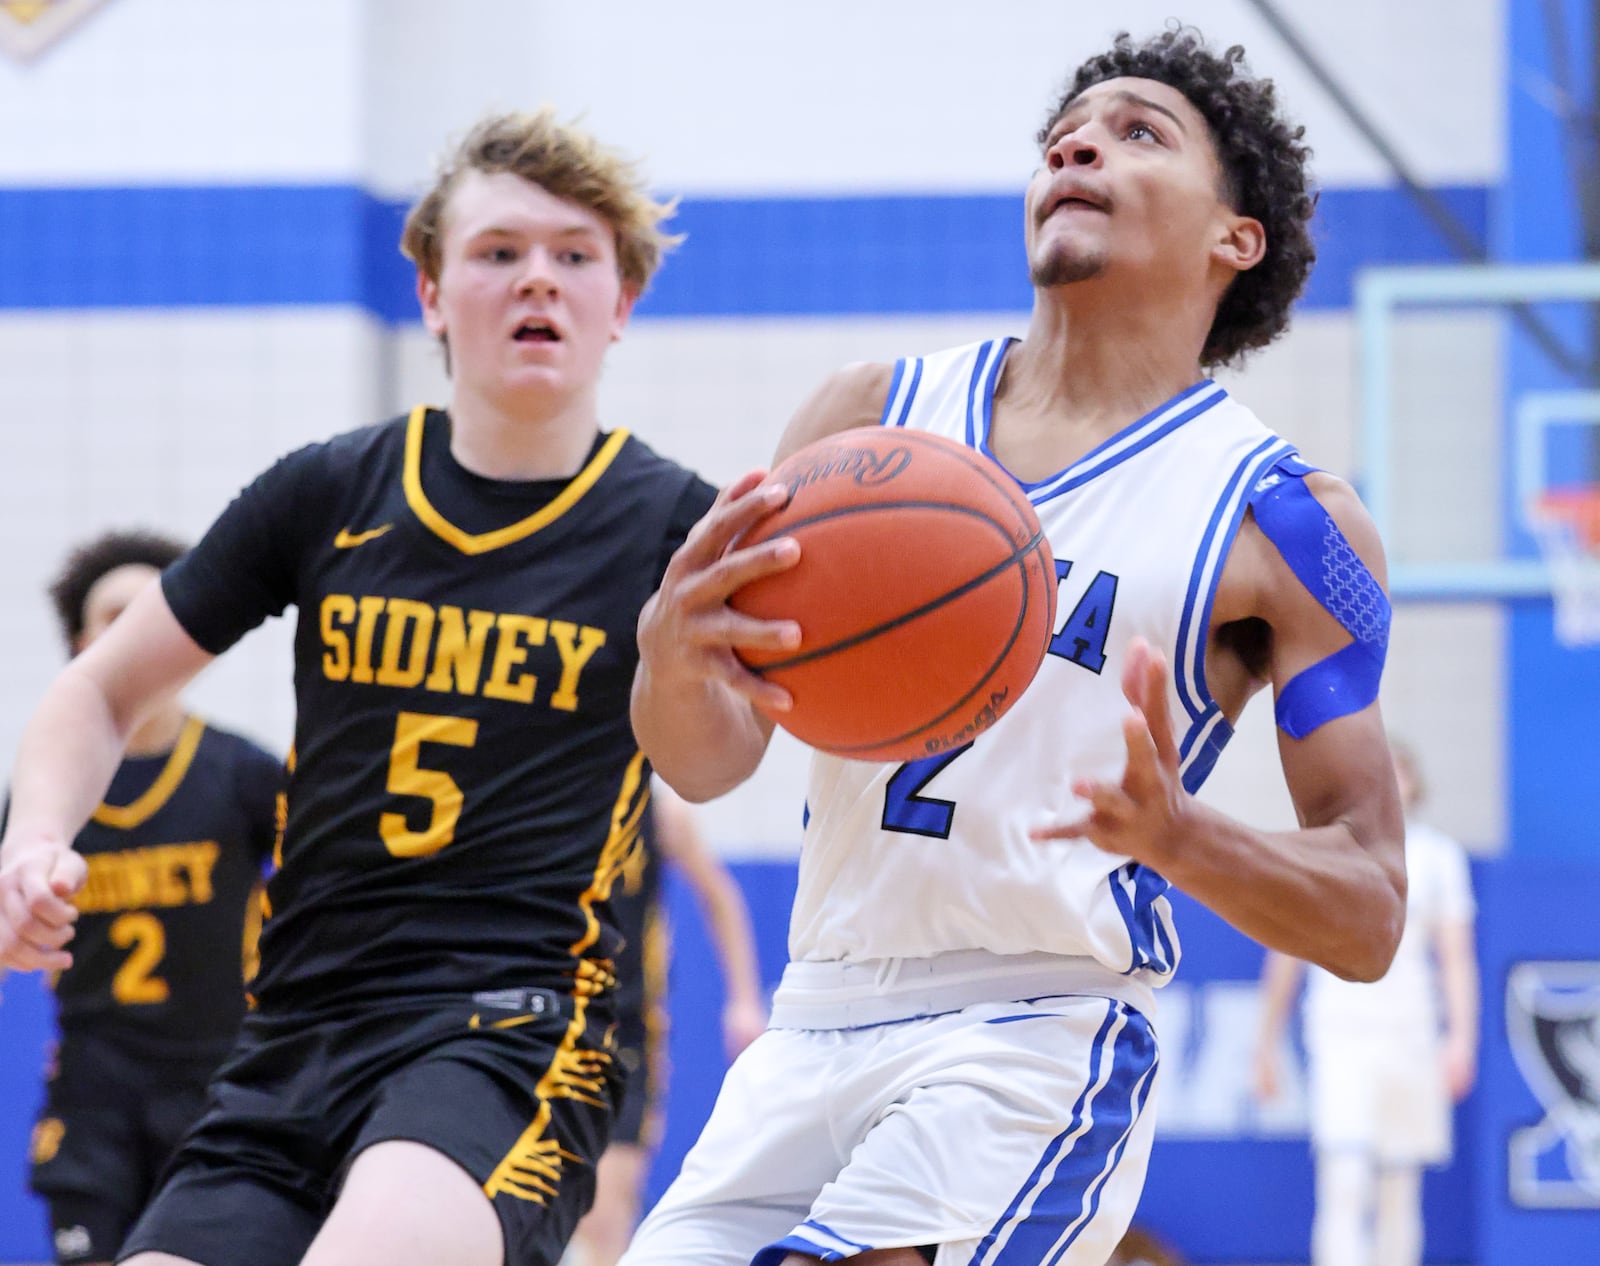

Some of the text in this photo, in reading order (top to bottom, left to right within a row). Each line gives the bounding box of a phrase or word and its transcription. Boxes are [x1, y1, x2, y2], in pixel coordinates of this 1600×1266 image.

[320, 594, 607, 711] SIDNEY
[379, 711, 478, 858] 5
[110, 911, 170, 1004] 2
